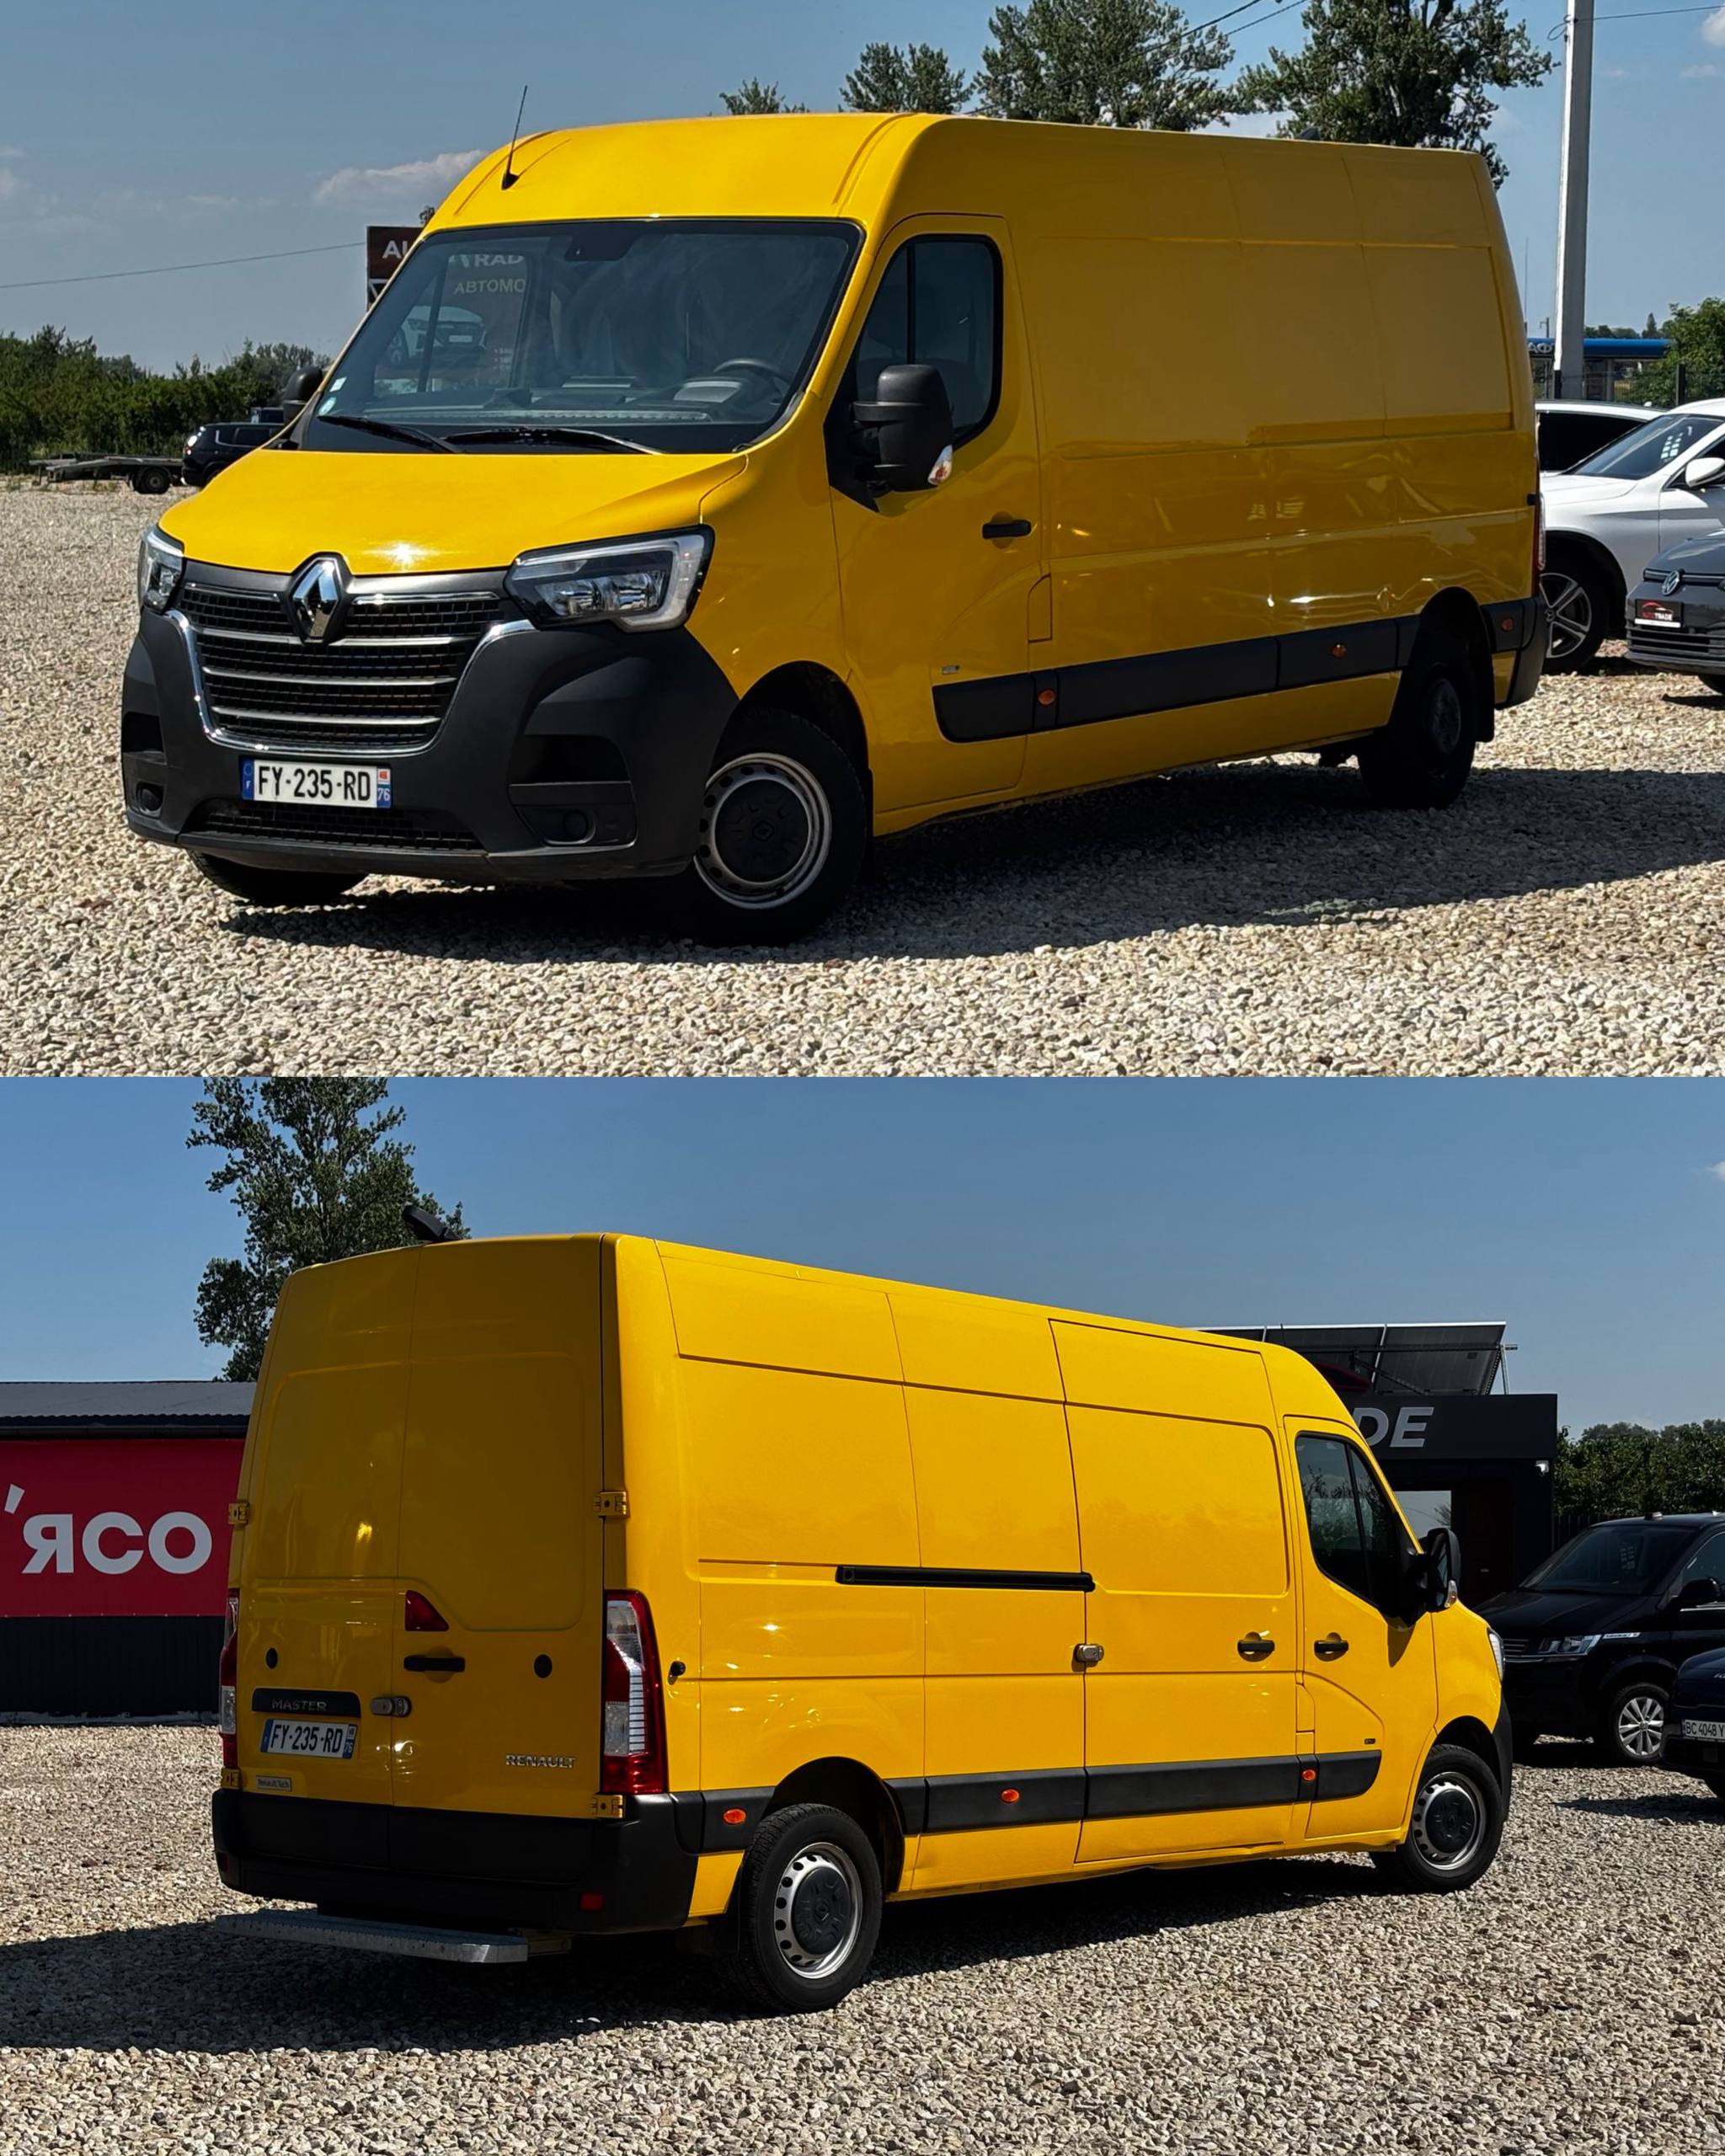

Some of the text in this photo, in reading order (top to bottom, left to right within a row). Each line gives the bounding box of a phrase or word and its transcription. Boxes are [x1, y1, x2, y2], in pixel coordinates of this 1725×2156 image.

[258, 766, 371, 802] FY-235-RD
[377, 787, 391, 801] 76
[271, 1698, 328, 1712] MASTER
[270, 1724, 344, 1753] FY-235-RD
[505, 1753, 576, 1769] RENAULT
